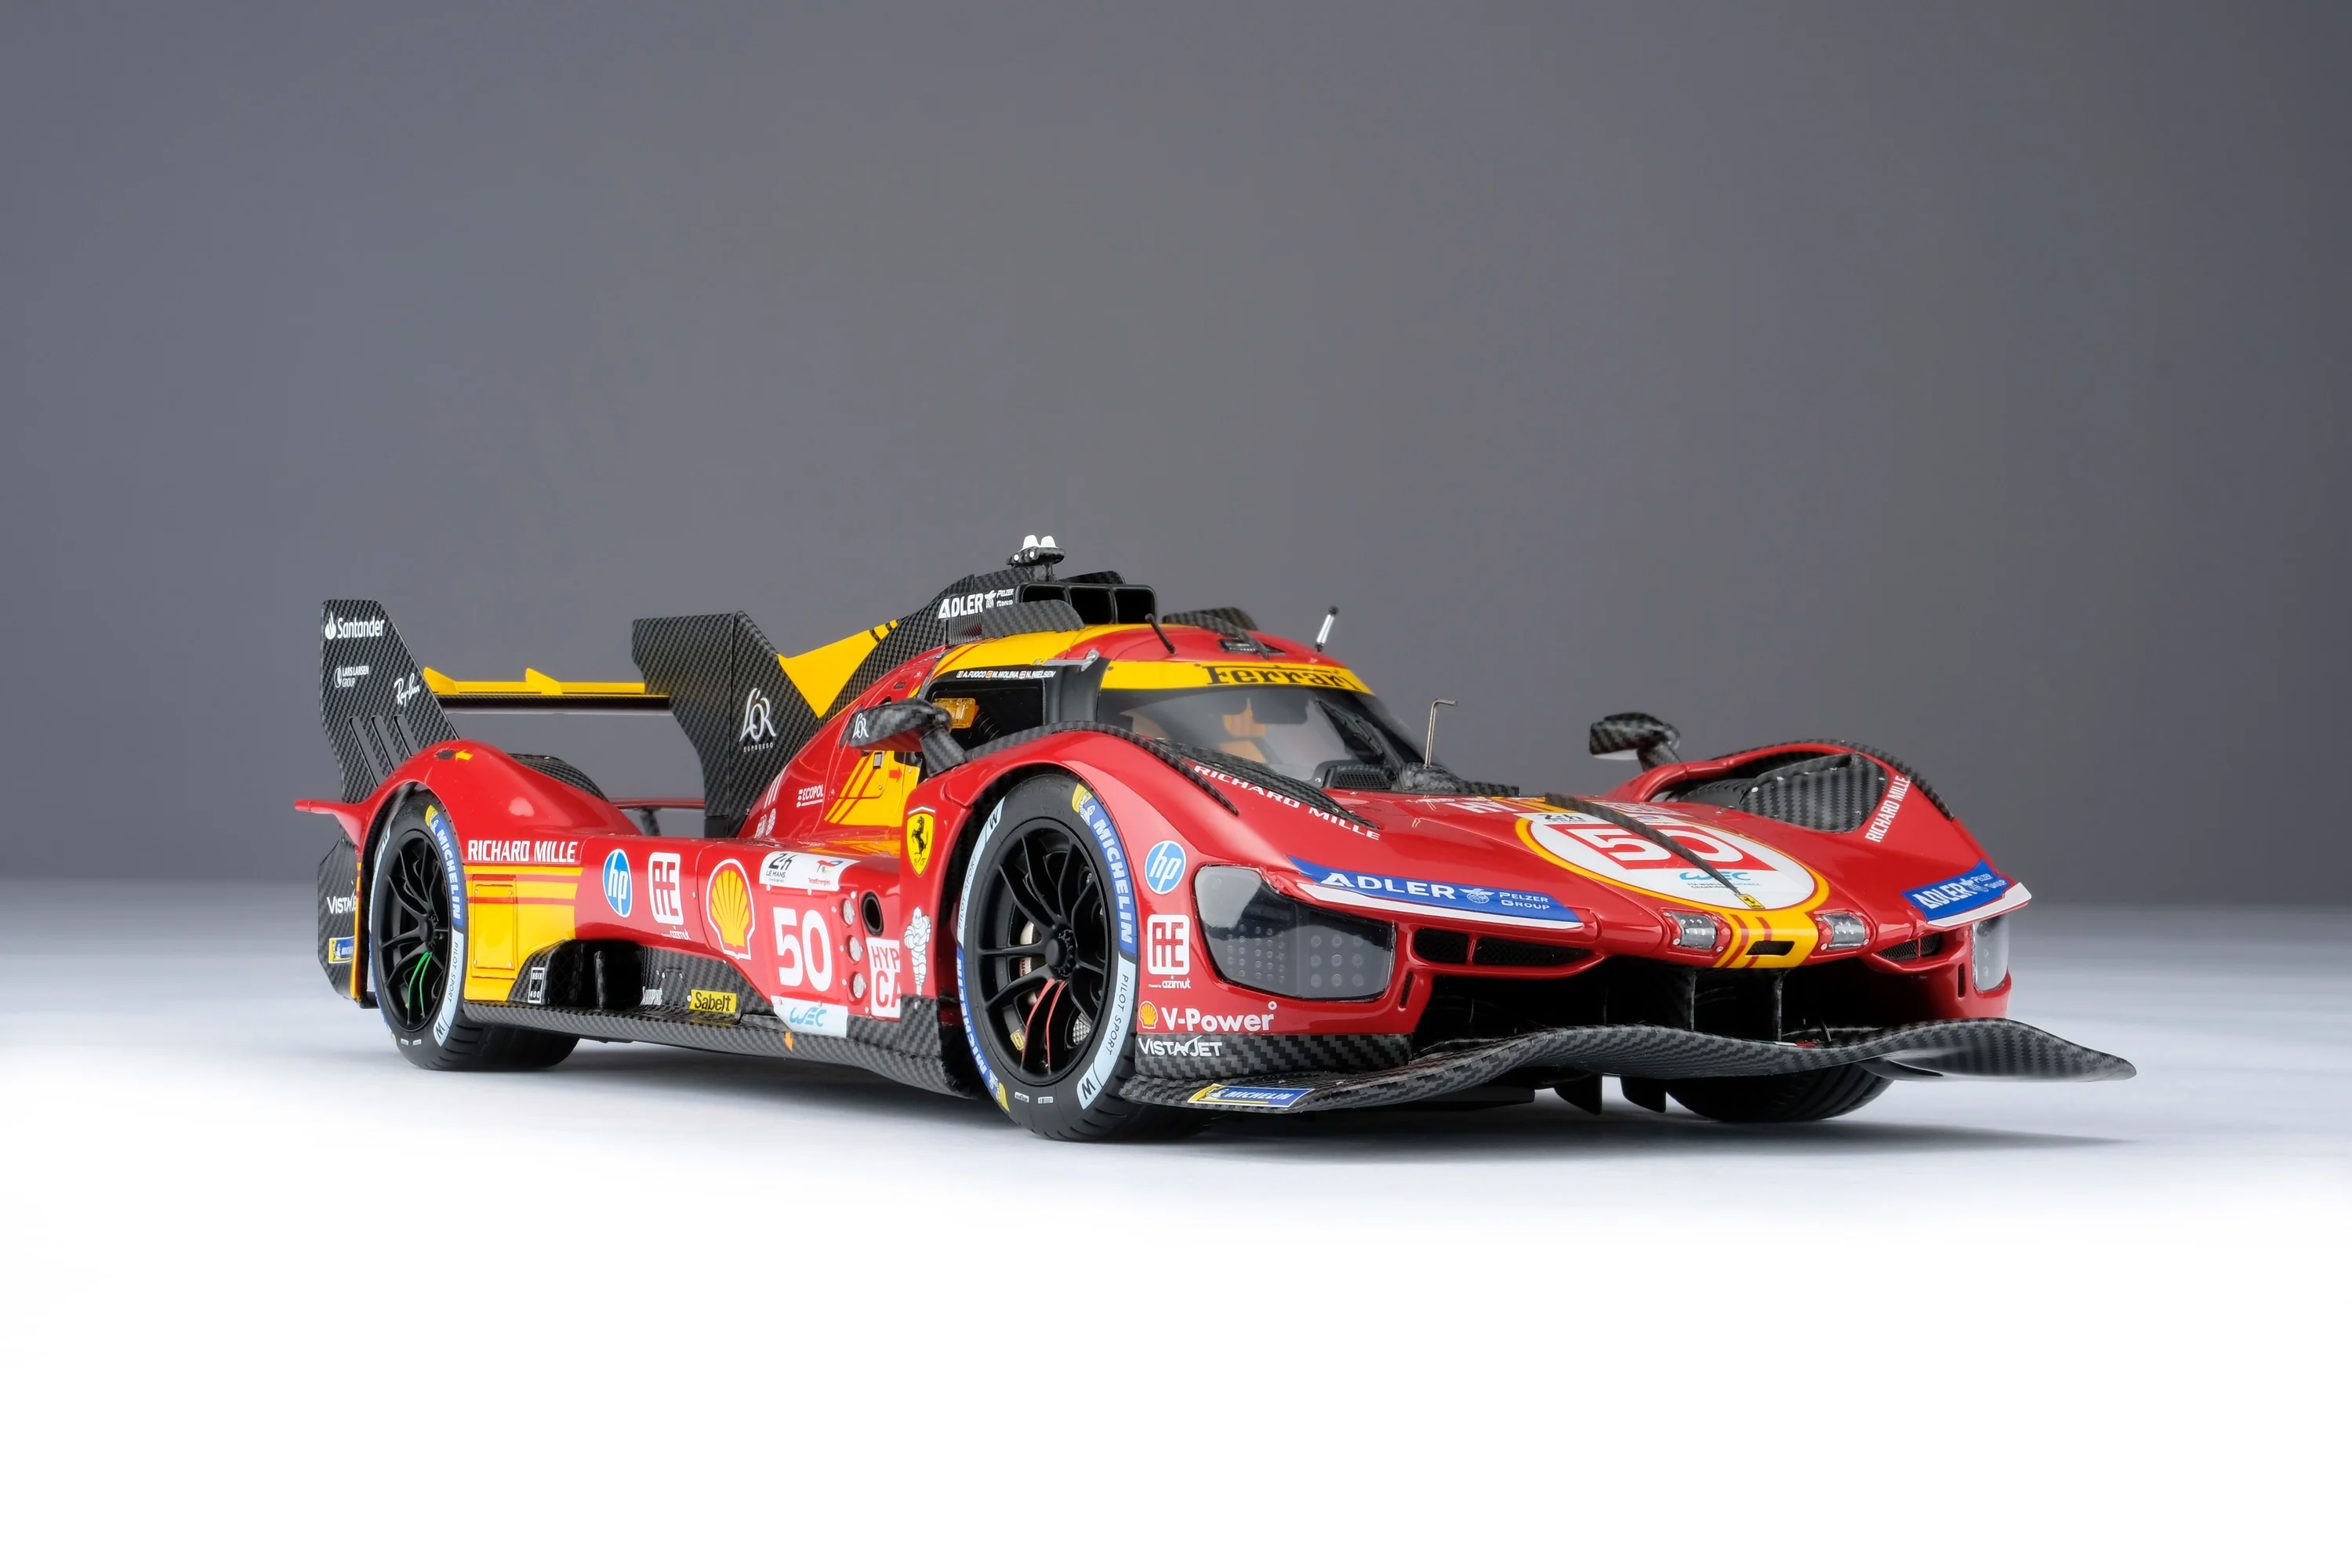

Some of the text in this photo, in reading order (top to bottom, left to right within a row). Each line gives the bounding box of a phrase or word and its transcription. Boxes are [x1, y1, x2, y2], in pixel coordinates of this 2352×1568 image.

[938, 593, 984, 619] ADLER
[337, 616, 385, 639] Santander
[342, 665, 369, 677] LARS LARSEN
[342, 677, 355, 688] GROUP
[1202, 664, 1363, 692] Ferrari
[394, 673, 421, 707] Ray-Ban
[743, 742, 775, 753] ESPRESSO
[802, 784, 823, 801] ECOPOL
[1194, 765, 1381, 840] RICHARD MILLE
[1865, 775, 1911, 843] RICHARD MILLE
[468, 840, 578, 862] RICHARD MILLE
[1566, 829, 1744, 862] 50
[437, 829, 461, 920] MICHELIN
[1149, 841, 1182, 893] hp
[607, 851, 630, 916] hp
[1093, 819, 1133, 944] MICHELIN
[1320, 872, 1457, 900] ADLER
[1499, 891, 1549, 903] PELZER
[1501, 899, 1551, 910] GROUP
[1912, 883, 1978, 909] ADLER
[773, 906, 833, 992] 50
[448, 975, 456, 1004] SPORT
[1162, 975, 1192, 989] azimut
[695, 992, 731, 1011] Sabelt
[1108, 974, 1129, 1055] PILOT SPORT
[789, 1007, 827, 1027] WEC
[956, 956, 988, 1075] MICHELIN
[1161, 1007, 1275, 1033] V-Power
[1225, 1091, 1294, 1100] MICHELIN
